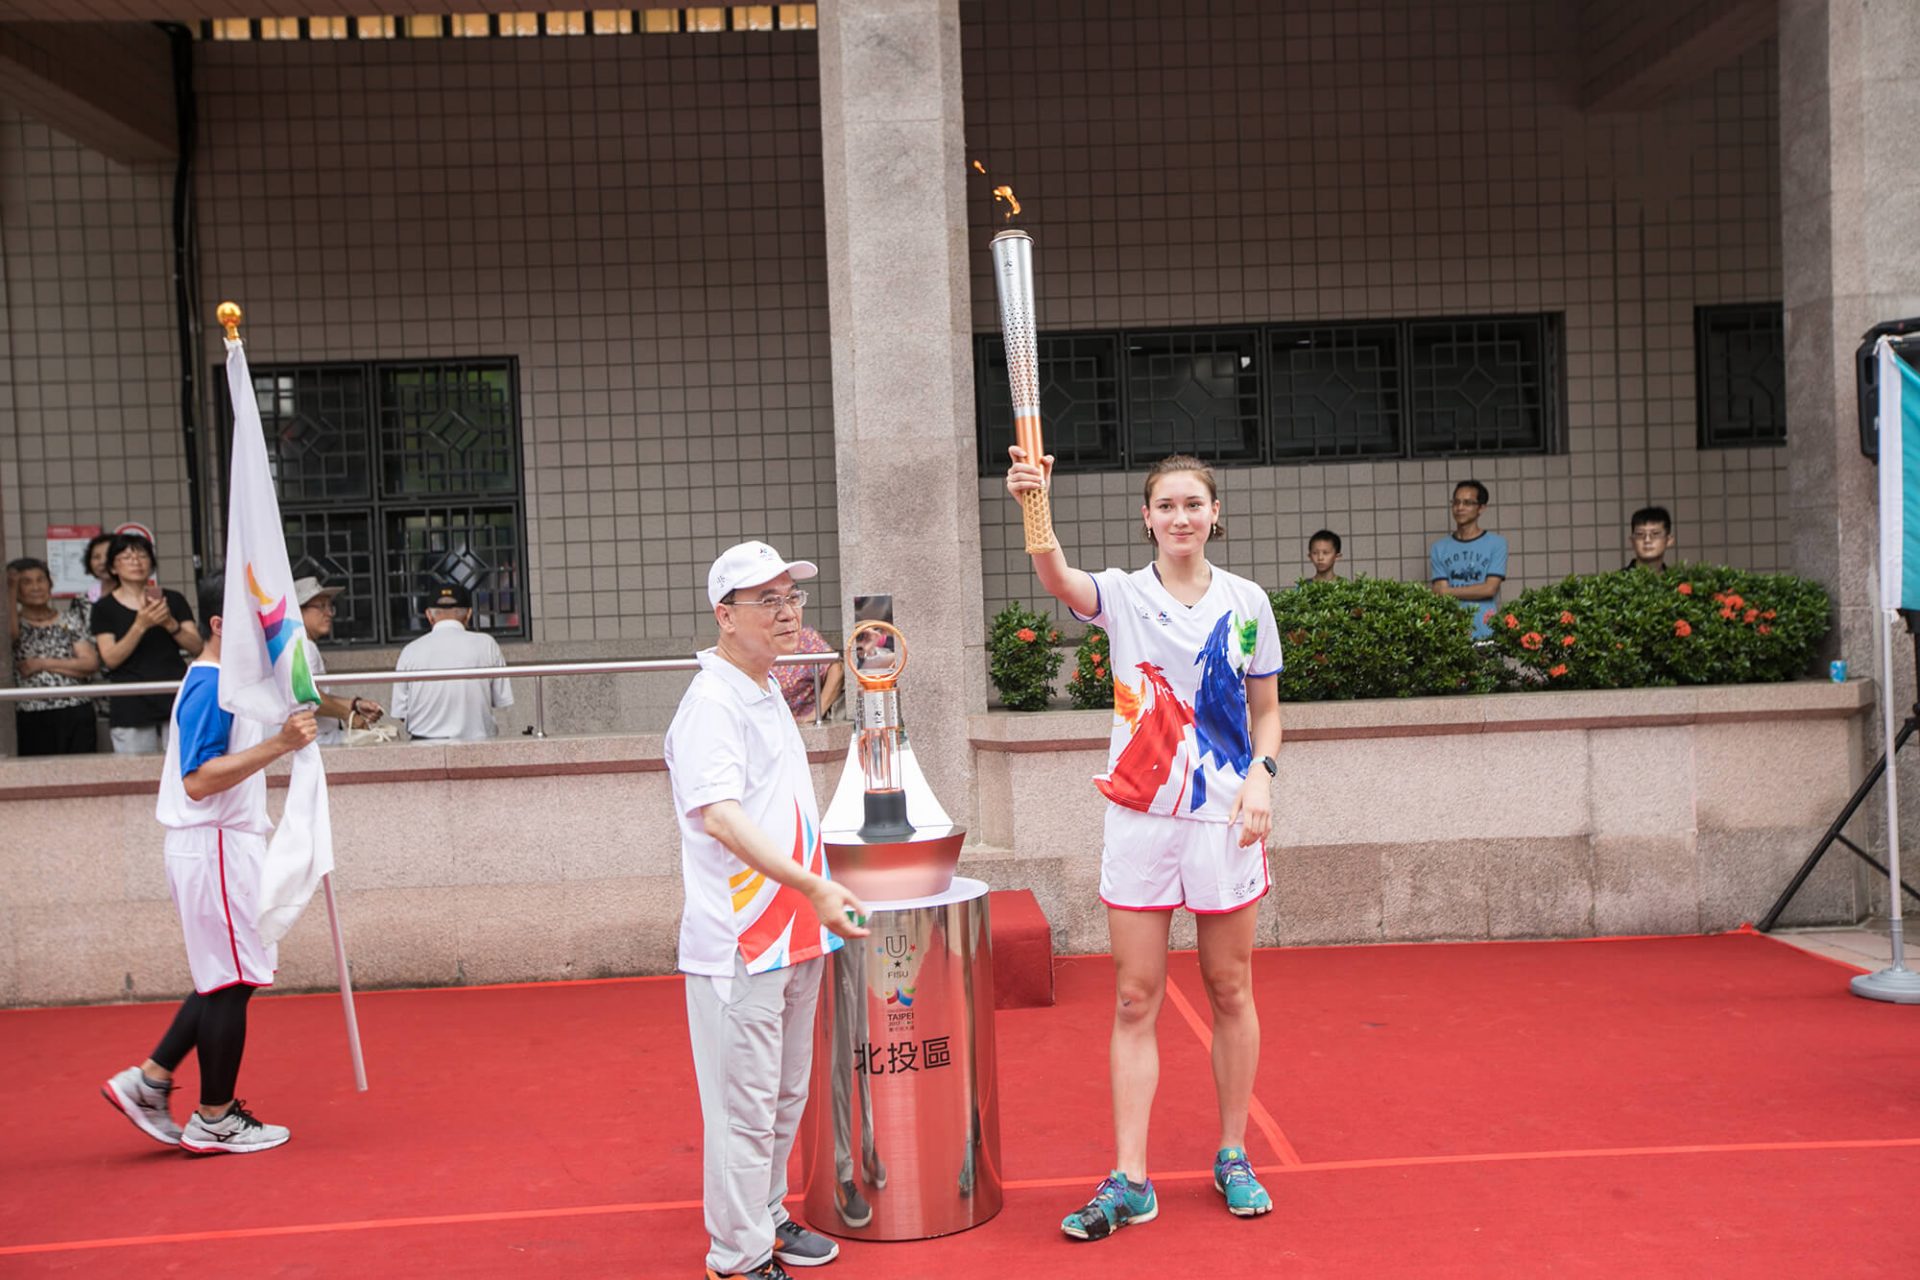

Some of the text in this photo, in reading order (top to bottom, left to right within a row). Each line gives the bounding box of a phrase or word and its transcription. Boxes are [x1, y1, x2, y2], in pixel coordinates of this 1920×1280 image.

[887, 970, 909, 979] FISU
[887, 1012, 914, 1021] TAIPEI
[854, 1036, 951, 1075] 北投區
